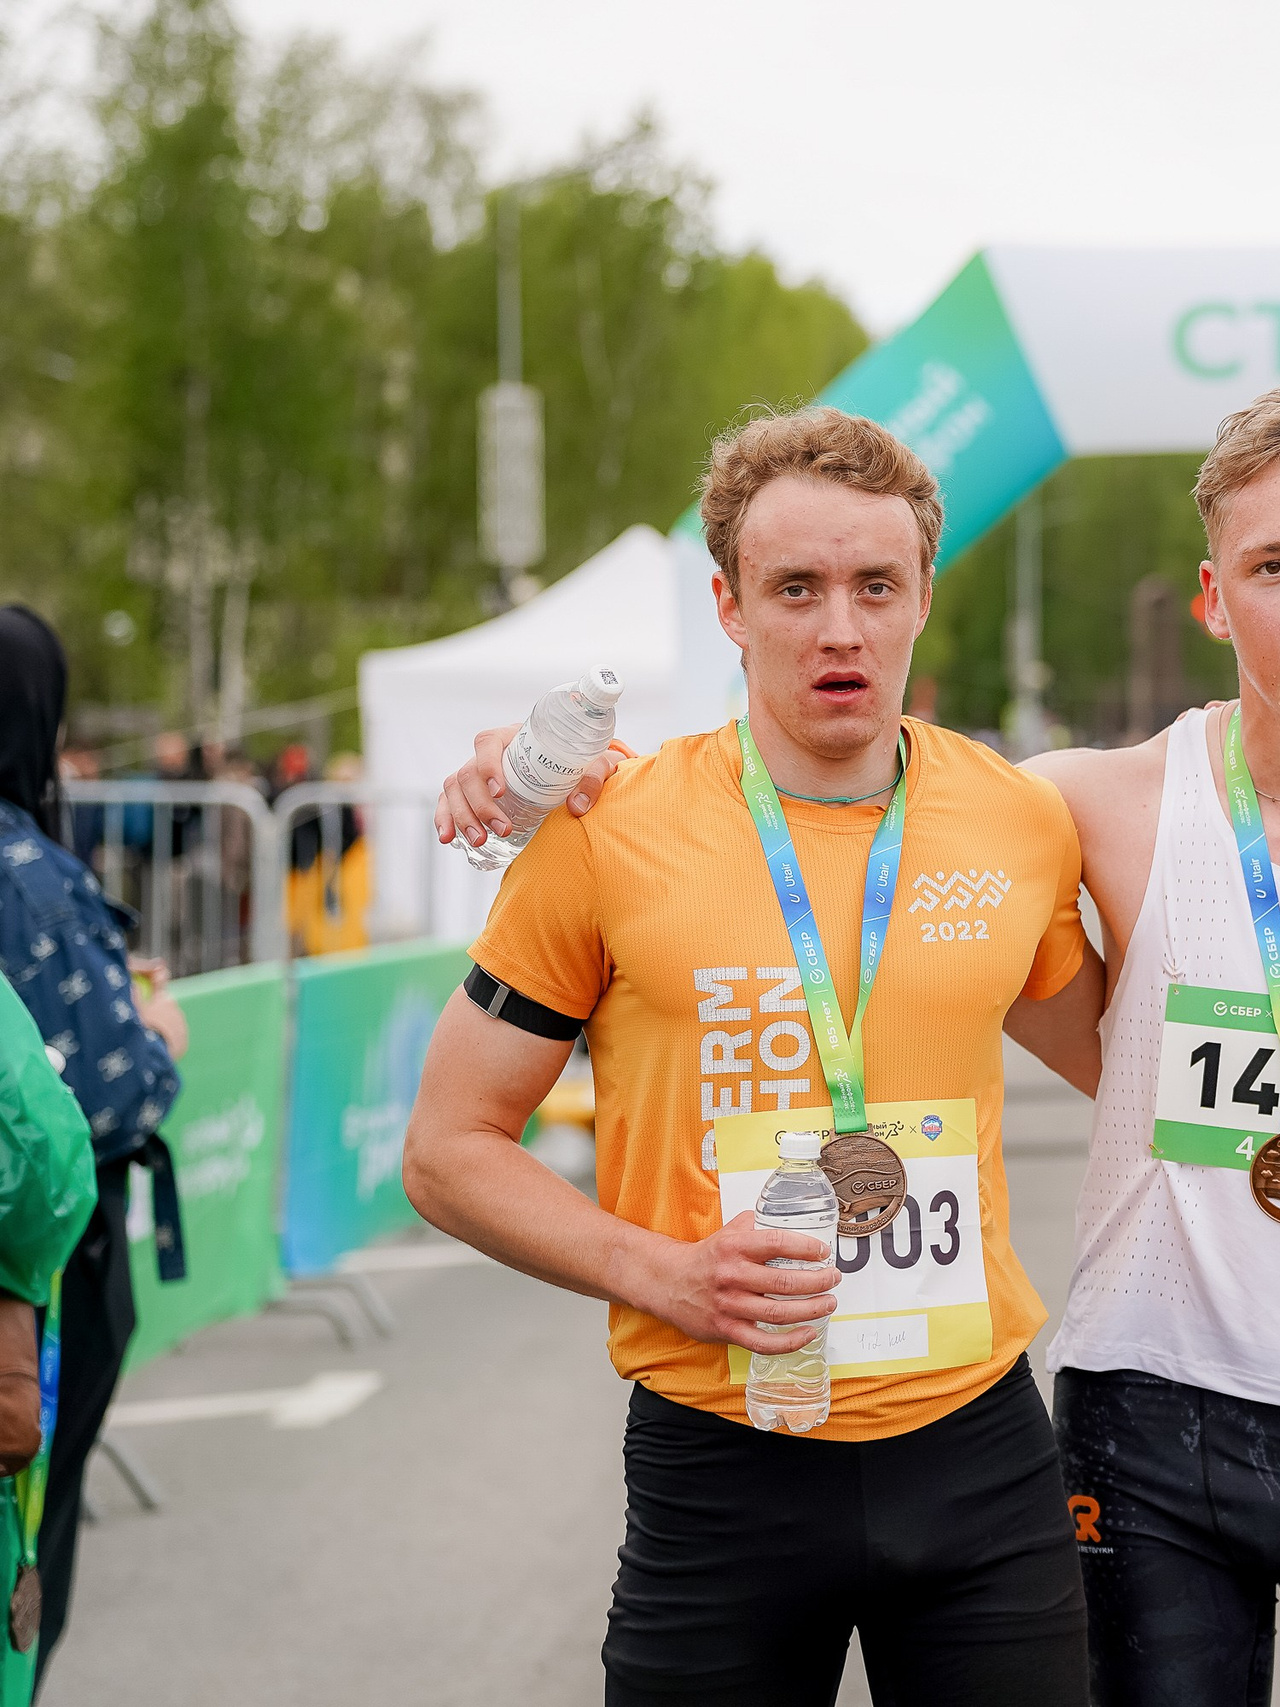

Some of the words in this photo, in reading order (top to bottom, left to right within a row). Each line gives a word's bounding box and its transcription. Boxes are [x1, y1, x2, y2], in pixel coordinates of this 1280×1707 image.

[745, 756, 757, 777] 185
[1229, 749, 1238, 771] 185
[780, 861, 798, 888] Utair
[877, 862, 890, 887] Utair
[1252, 858, 1263, 883] Utair
[921, 920, 990, 943] 2022
[1264, 927, 1279, 960] СБЕР
[801, 931, 818, 966] СБЕР
[868, 931, 878, 966] СБЕР
[822, 1000, 835, 1024] лет
[1229, 1005, 1261, 1017] СБЕР
[827, 1026, 840, 1050] 185
[867, 1179, 897, 1191] СБЕР
